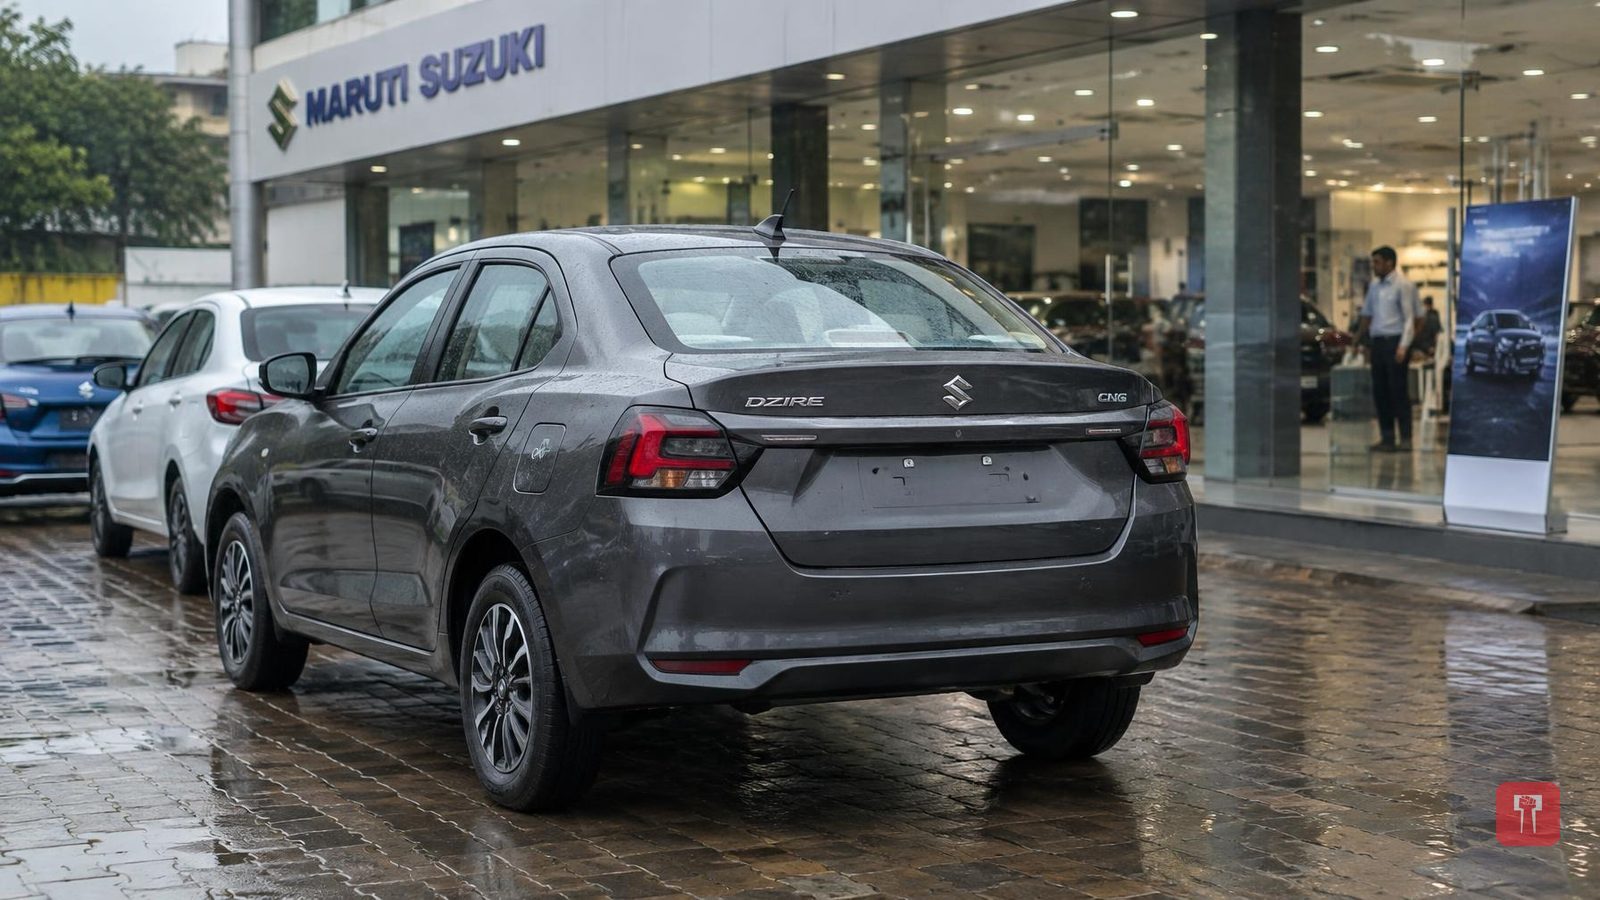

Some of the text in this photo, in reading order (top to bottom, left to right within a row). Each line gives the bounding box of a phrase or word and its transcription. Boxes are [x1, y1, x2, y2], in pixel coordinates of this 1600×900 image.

[306, 24, 546, 127] MARUTI SUZUKI
[745, 396, 825, 408] DZIRE
[1097, 392, 1128, 403] CNG
